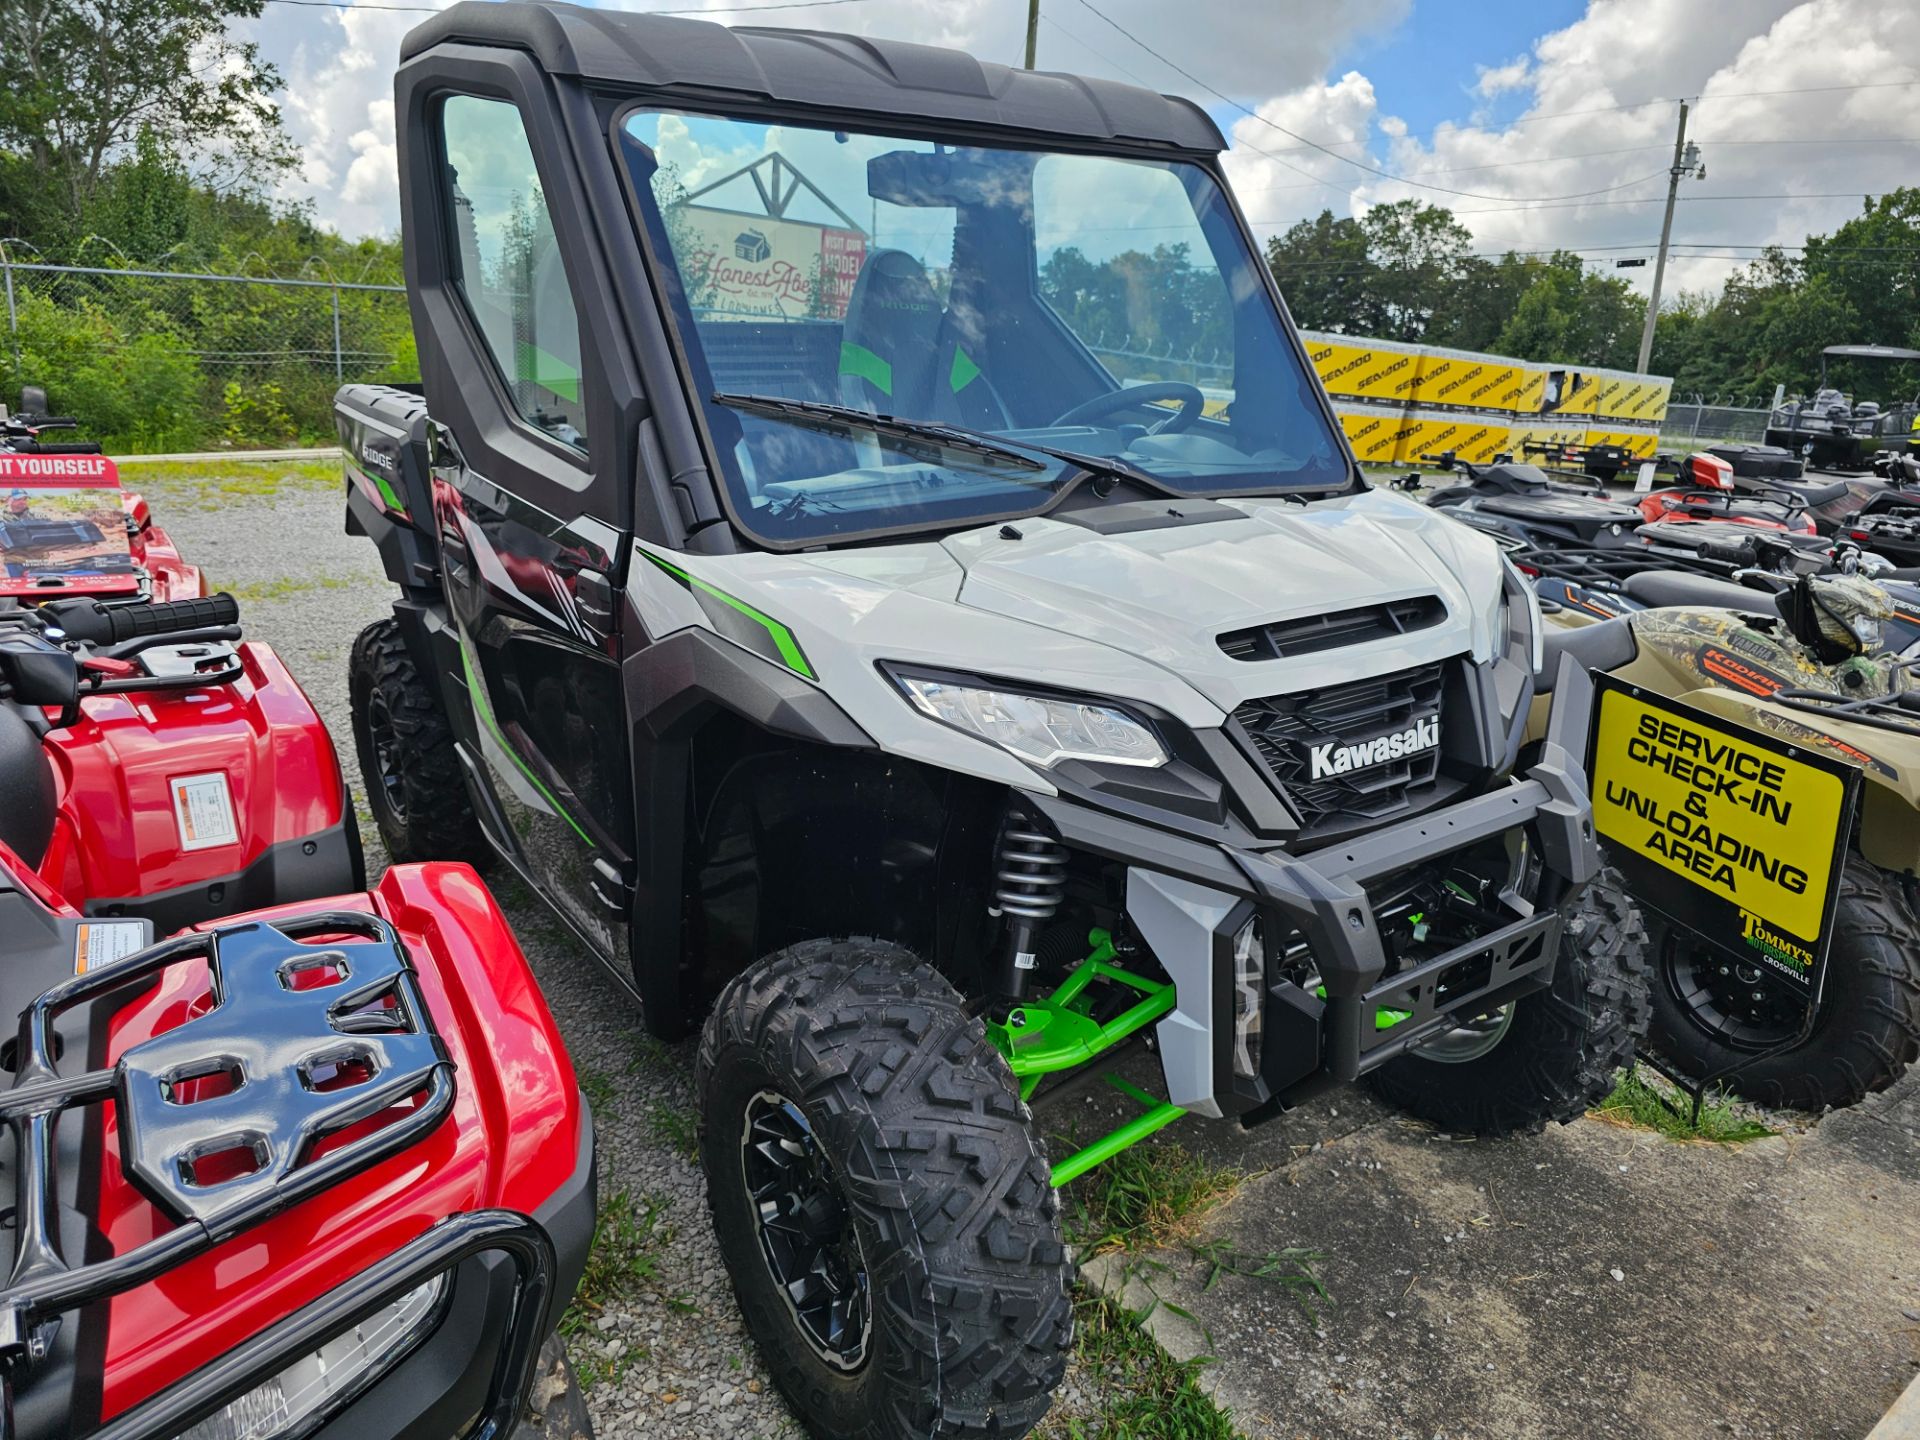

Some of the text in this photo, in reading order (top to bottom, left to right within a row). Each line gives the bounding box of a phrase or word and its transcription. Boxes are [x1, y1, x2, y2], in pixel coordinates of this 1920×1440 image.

[771, 260, 812, 302] Abe
[16, 459, 106, 475] YOURSELF
[362, 446, 393, 471] RIDGE
[1731, 635, 1773, 660] YAMAHA
[1704, 648, 1784, 692] KODIAK
[1311, 715, 1439, 780] Kawasaki
[1638, 713, 1786, 793] SERVICE
[1627, 737, 1792, 826] CHECK-IN
[1684, 790, 1709, 820] &
[1605, 779, 1809, 895] UNLOADING
[1644, 830, 1737, 893] AREA
[1739, 907, 1814, 966] TOMMY'S
[1746, 934, 1805, 974] MOTORSPORTS
[1763, 954, 1811, 986] CROSSVILLE
